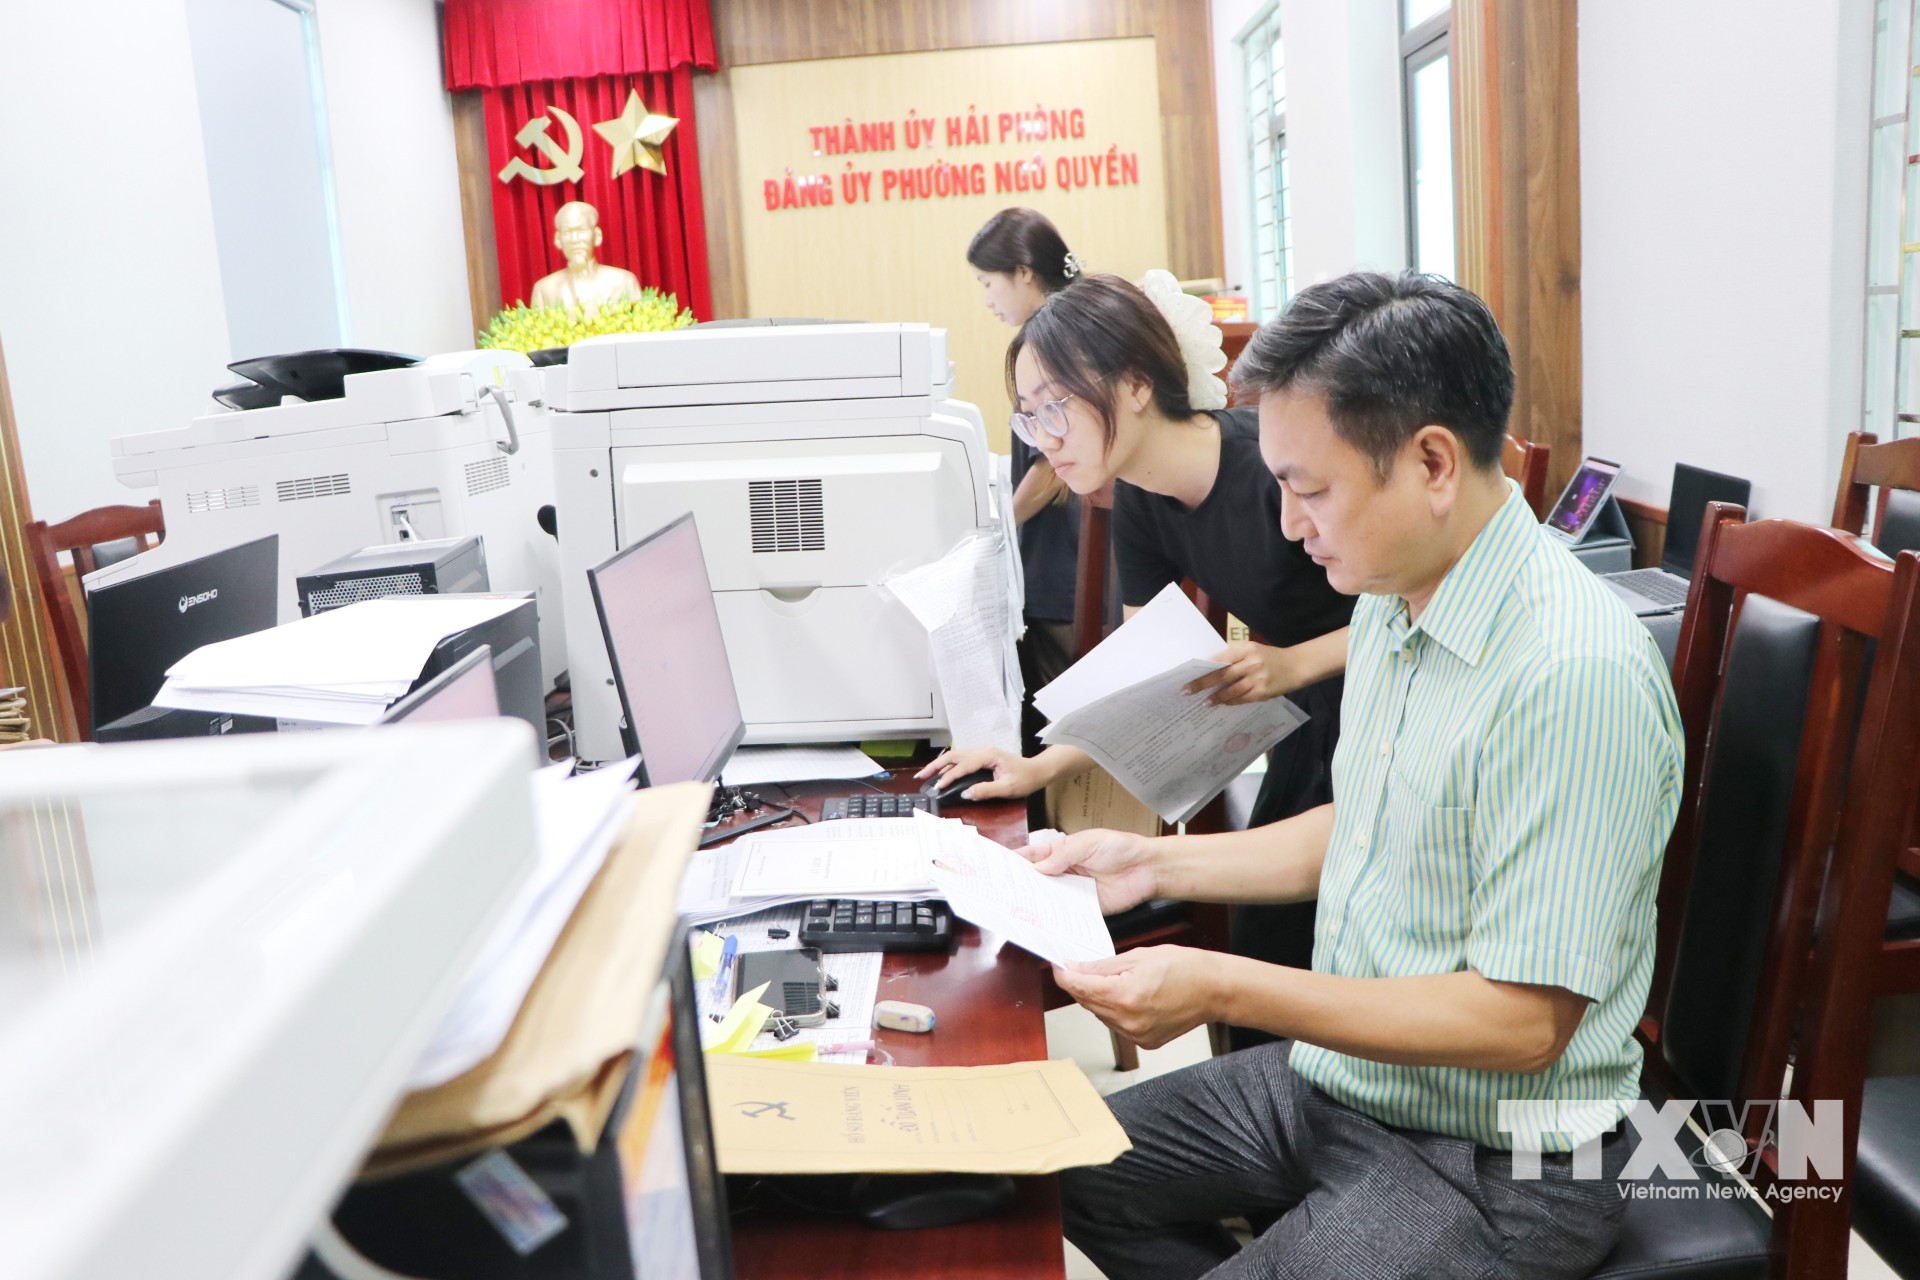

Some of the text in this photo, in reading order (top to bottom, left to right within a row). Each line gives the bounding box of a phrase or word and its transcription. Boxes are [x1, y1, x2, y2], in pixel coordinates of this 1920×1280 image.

[809, 104, 1085, 157] THÀNH ỦY HẢI PHÒNG
[764, 166, 833, 211] ĐẢNG
[841, 162, 871, 203] ỦY
[882, 160, 985, 200] PHƯỜNG
[1056, 144, 1139, 191] QUYỀN
